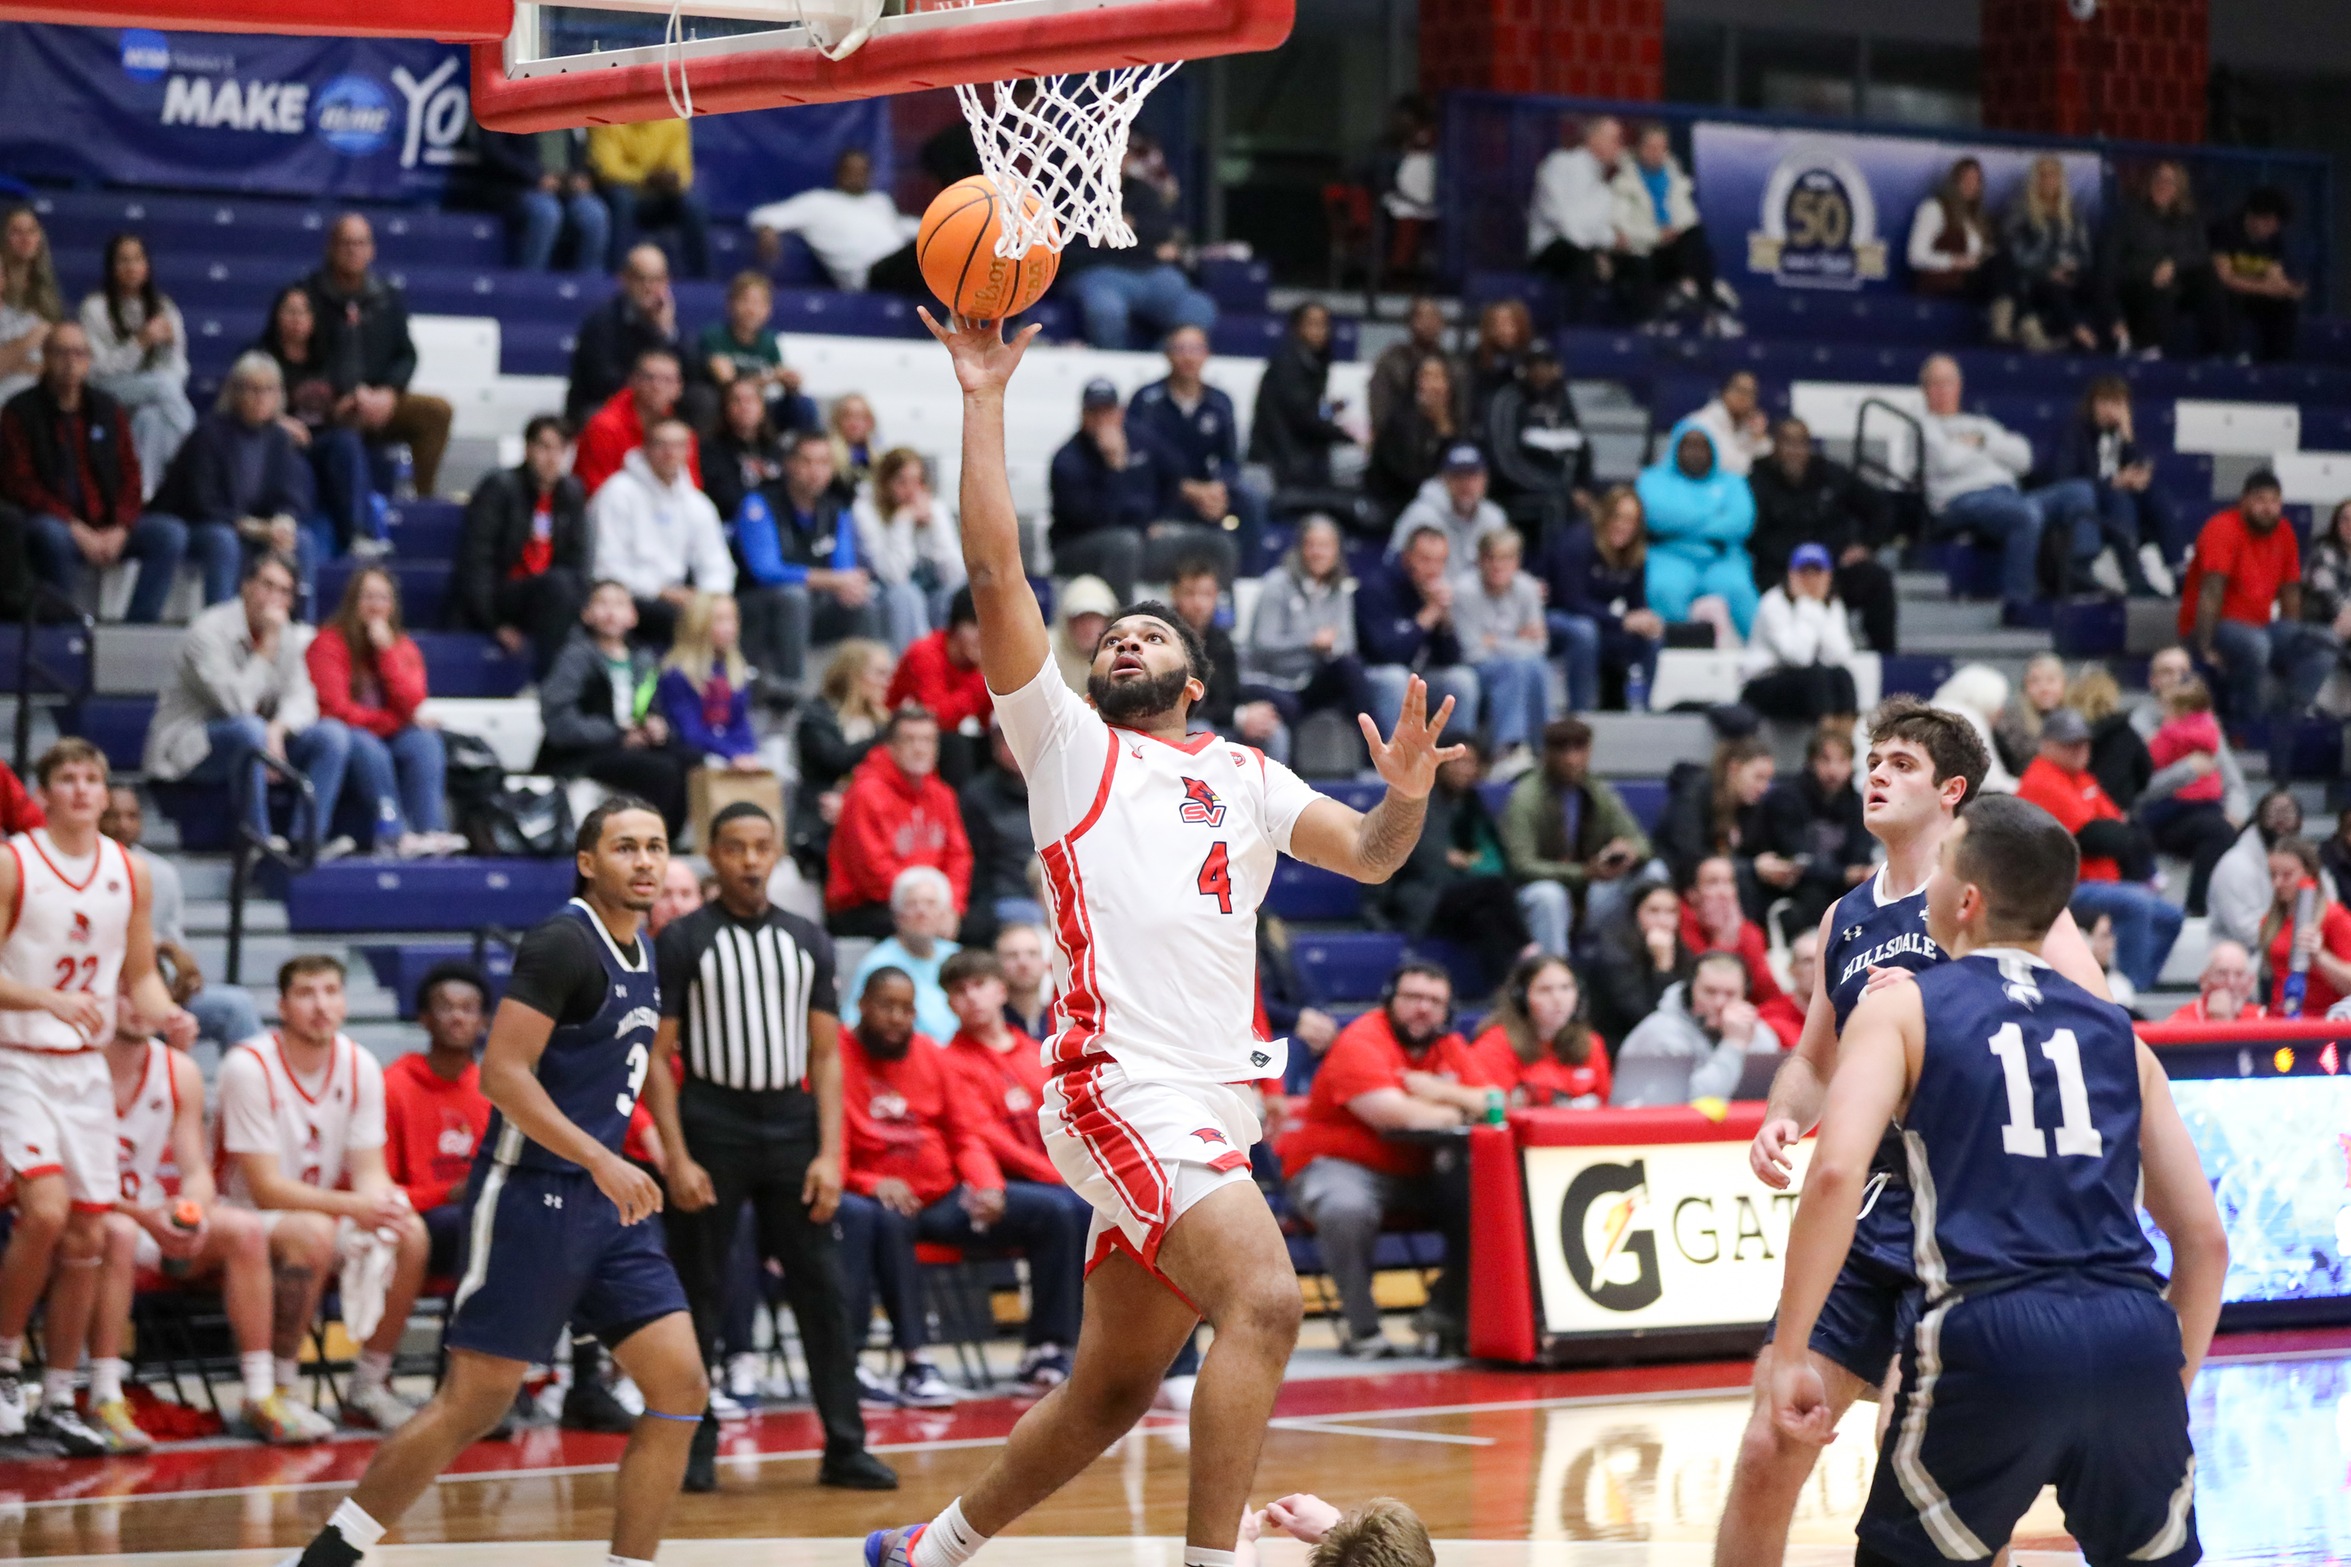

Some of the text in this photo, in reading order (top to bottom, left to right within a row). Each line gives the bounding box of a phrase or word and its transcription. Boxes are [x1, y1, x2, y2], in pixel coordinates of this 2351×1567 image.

[161, 75, 309, 133] MAKE
[1791, 190, 1848, 248] 50
[1180, 802, 1226, 828] SV
[1197, 841, 1233, 915] 4
[54, 955, 98, 993] 22
[1840, 932, 1937, 985] HILLSDALE
[616, 1042, 649, 1118] 3
[1988, 1021, 2103, 1158] 11
